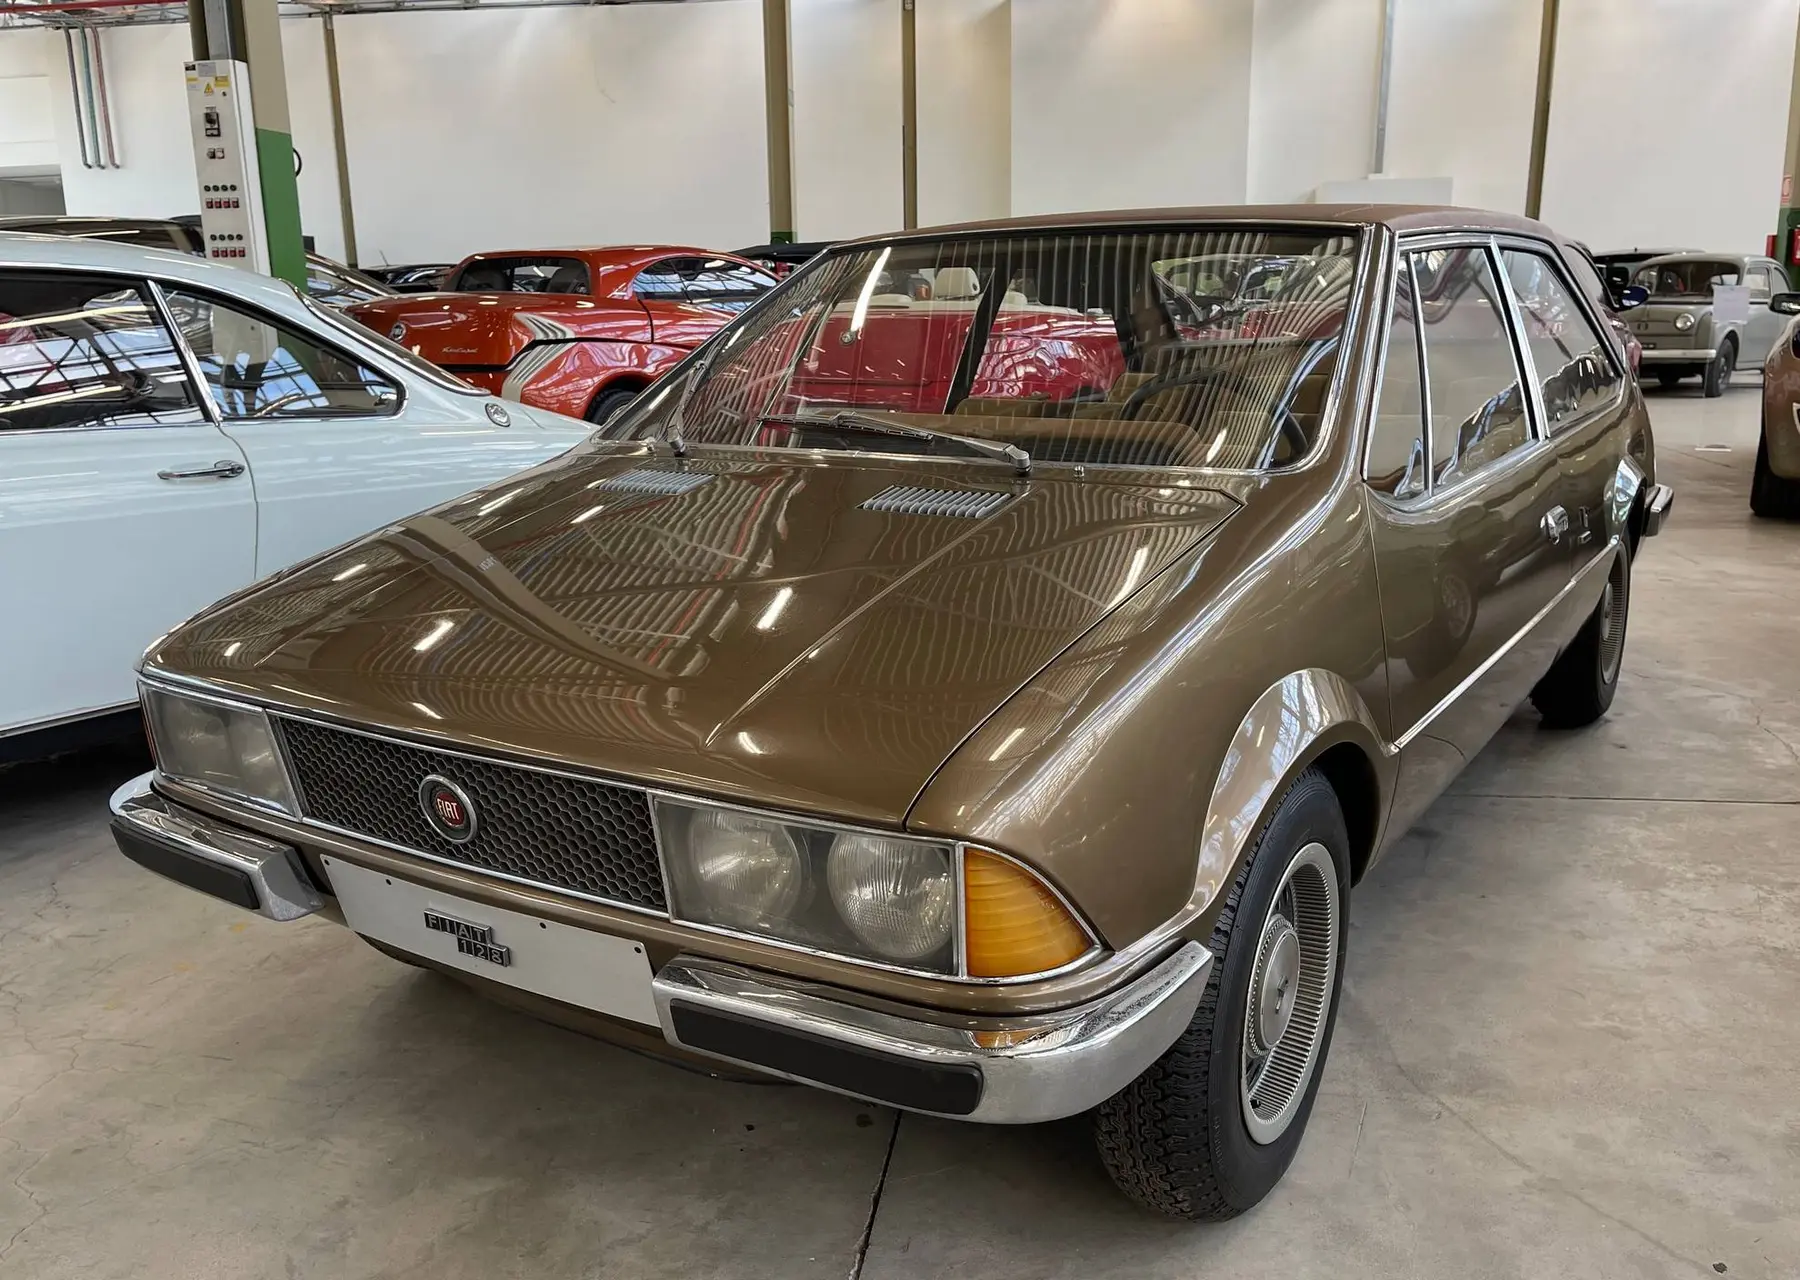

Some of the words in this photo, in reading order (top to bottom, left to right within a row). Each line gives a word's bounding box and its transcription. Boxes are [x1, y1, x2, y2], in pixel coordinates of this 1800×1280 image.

[436, 798, 460, 820] FIAT
[427, 914, 484, 942] FIAT
[461, 940, 503, 964] 128
